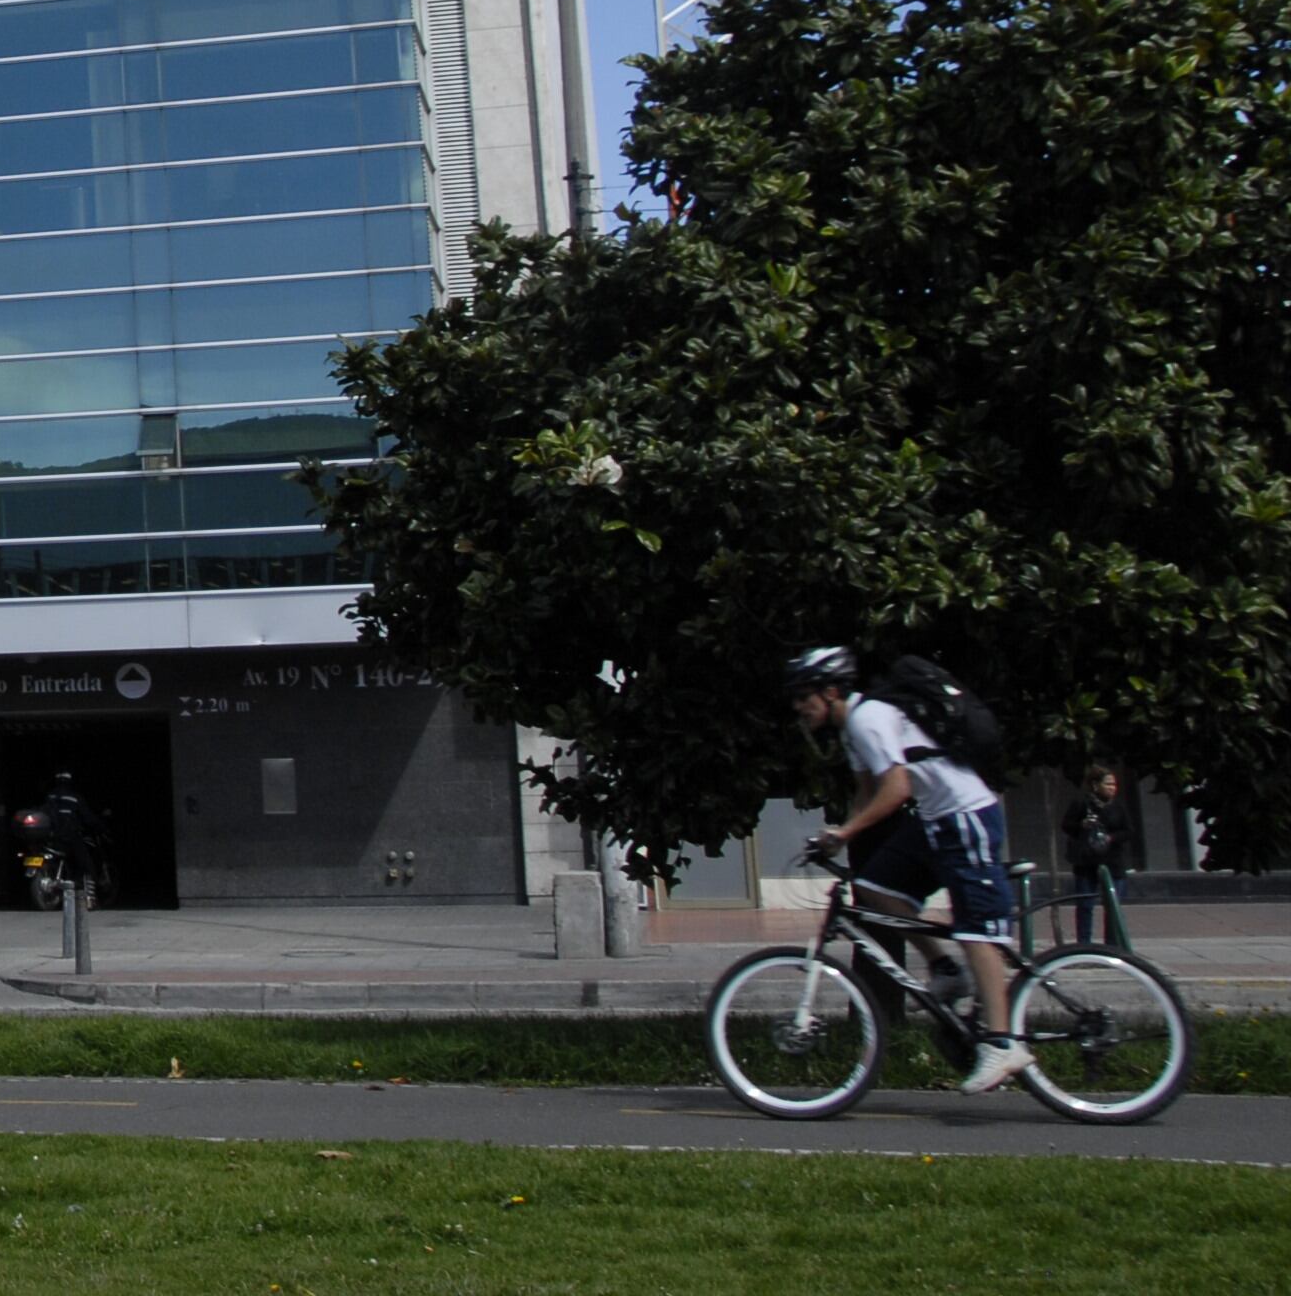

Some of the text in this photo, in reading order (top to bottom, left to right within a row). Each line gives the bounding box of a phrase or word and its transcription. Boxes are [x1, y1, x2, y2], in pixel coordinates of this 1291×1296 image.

[21, 672, 103, 694] Entrada
[243, 667, 269, 687] Av.
[276, 666, 300, 687] 19
[194, 697, 229, 714] 2.20
